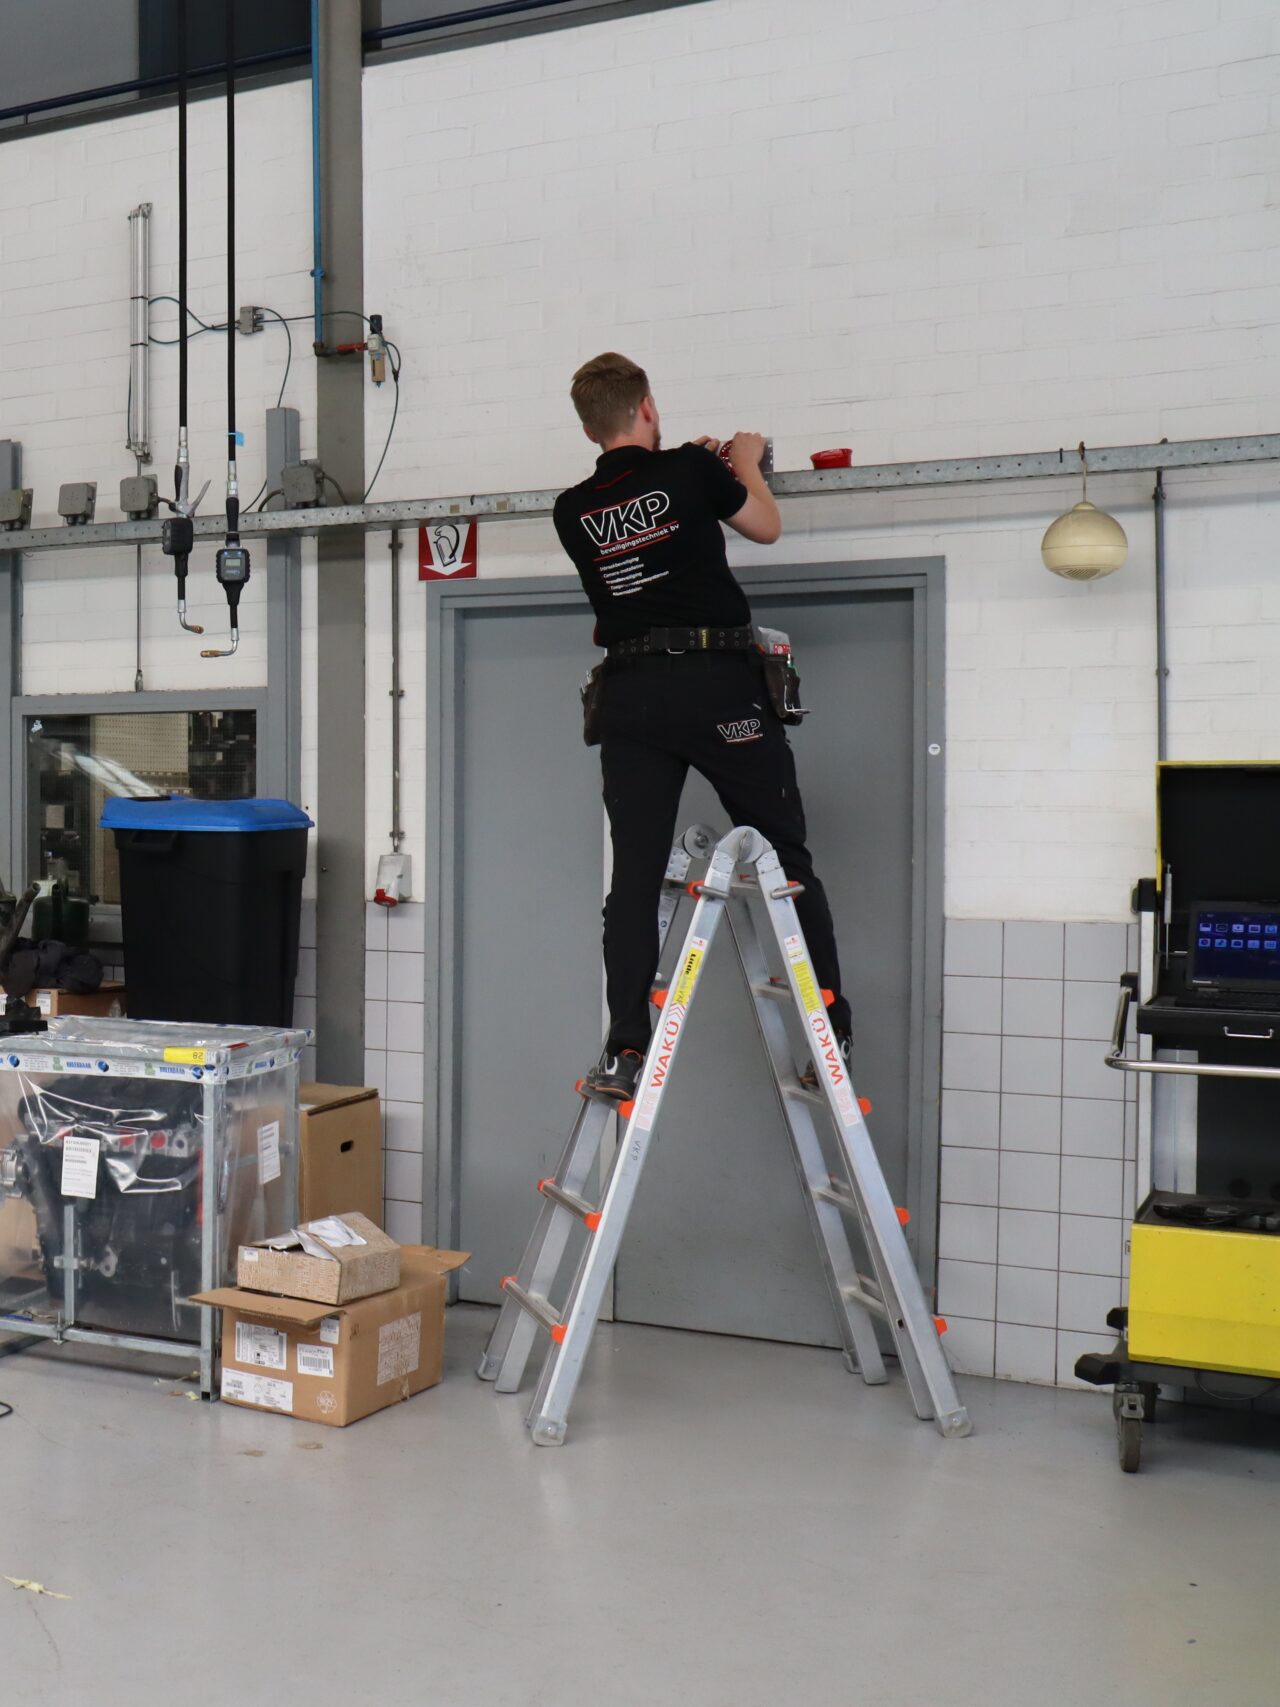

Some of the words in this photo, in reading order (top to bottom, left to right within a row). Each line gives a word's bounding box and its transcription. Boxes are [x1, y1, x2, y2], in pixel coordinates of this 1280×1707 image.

[580, 490, 670, 547] VKP
[669, 523, 680, 532] bv
[716, 718, 761, 740] VKP
[651, 1020, 680, 1088] WAKÜ
[811, 1016, 845, 1086] WAKÜ
